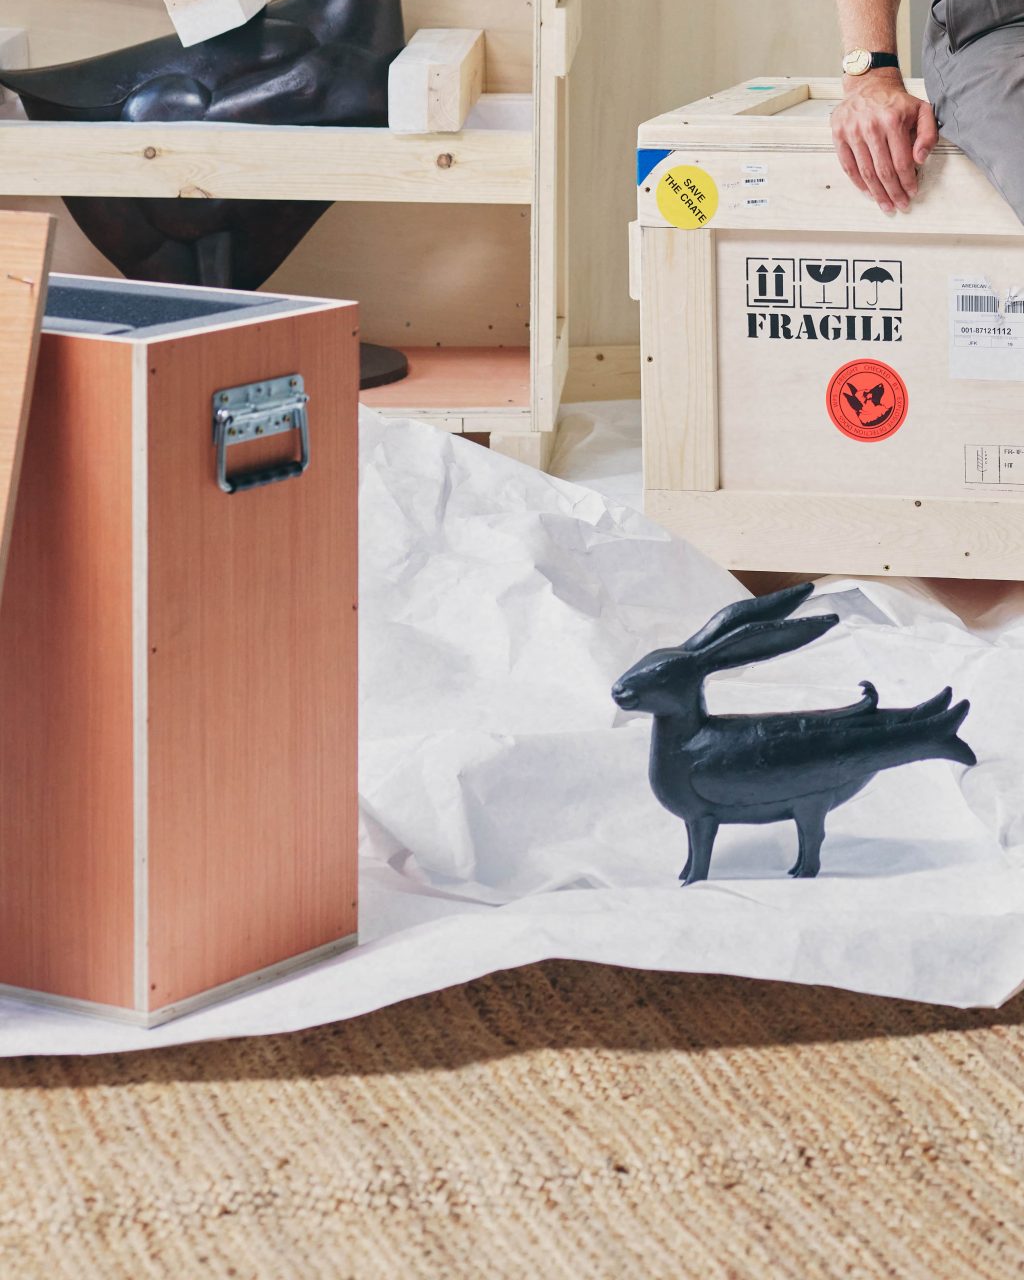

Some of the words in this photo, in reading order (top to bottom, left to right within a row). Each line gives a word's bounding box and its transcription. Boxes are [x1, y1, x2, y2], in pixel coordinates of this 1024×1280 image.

[664, 173, 682, 195] THE
[680, 193, 708, 224] CRATE
[683, 178, 706, 204] SAVE
[747, 312, 902, 342] FRAGILE
[960, 326, 1012, 336] 001-87121112
[863, 364, 891, 379] CHECKED
